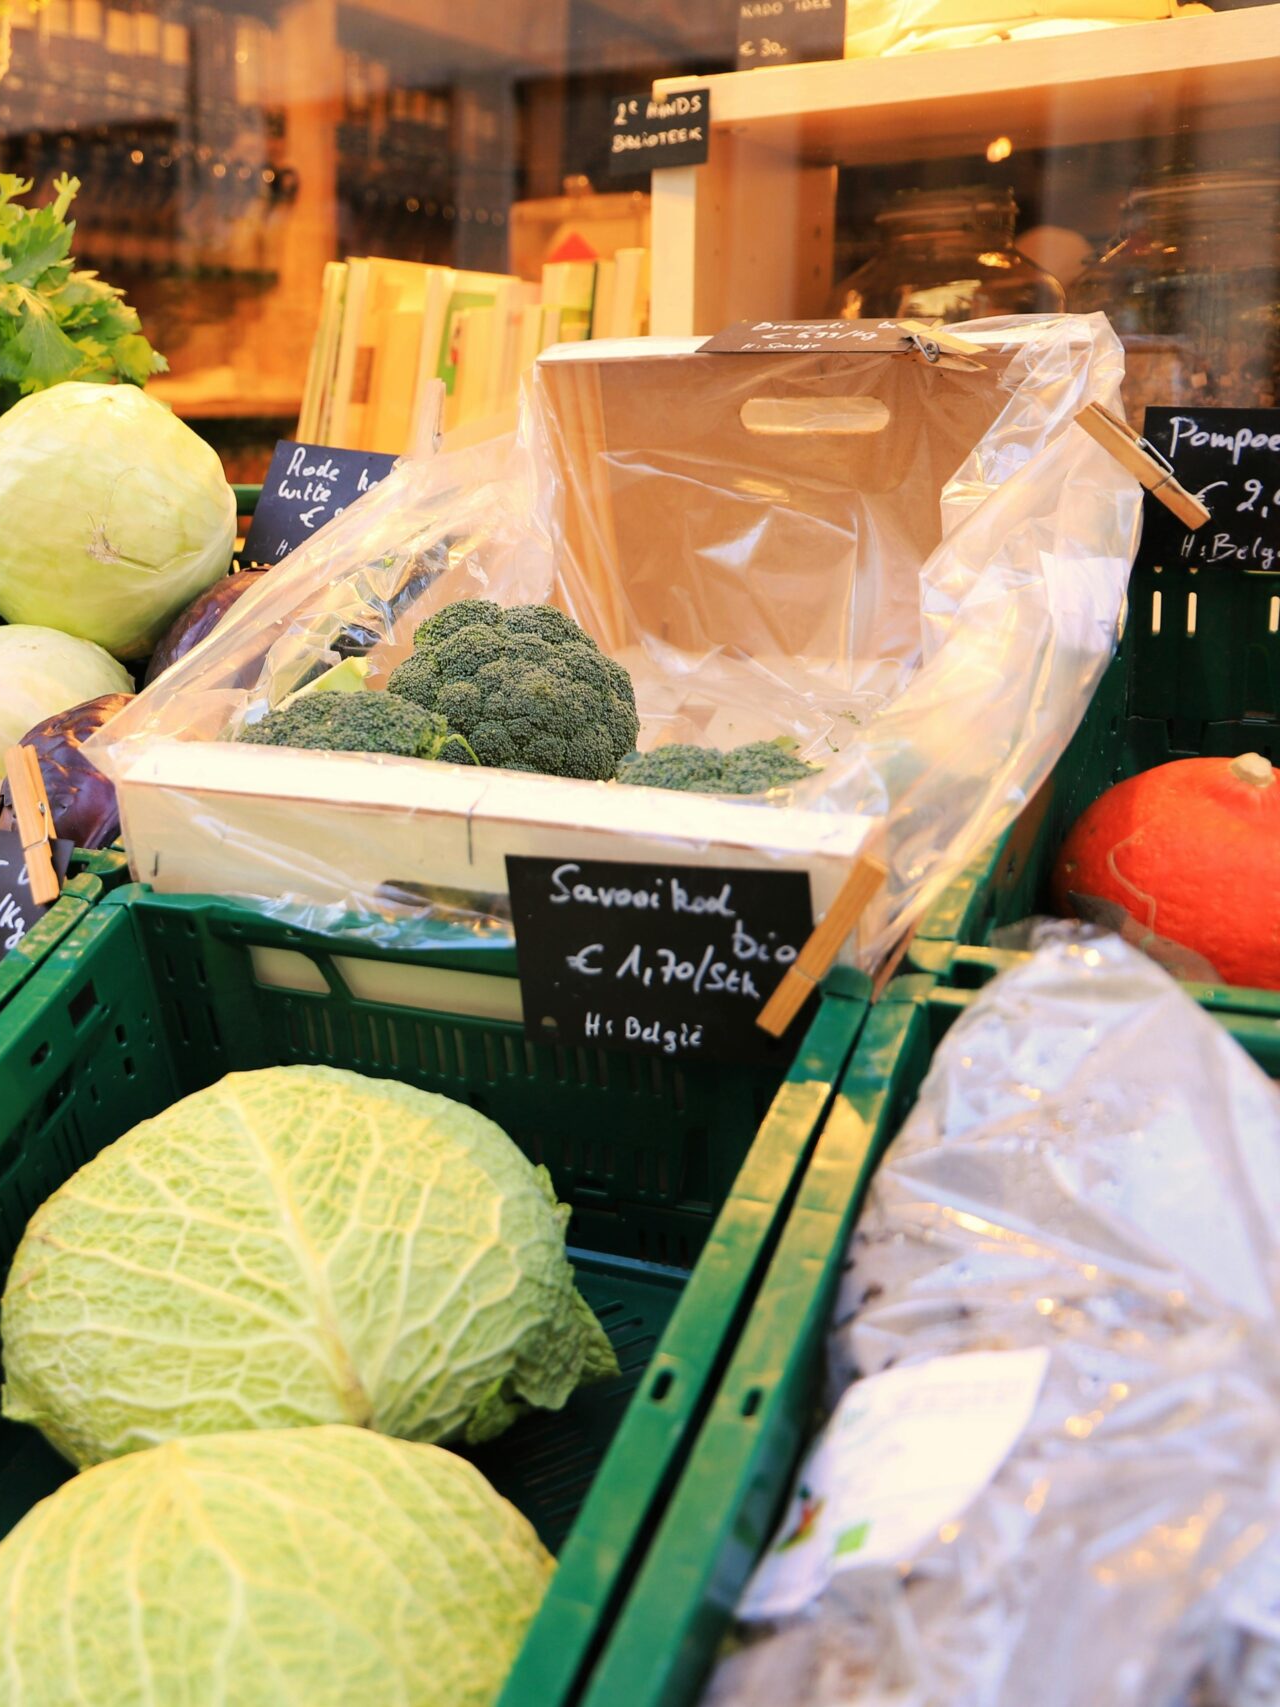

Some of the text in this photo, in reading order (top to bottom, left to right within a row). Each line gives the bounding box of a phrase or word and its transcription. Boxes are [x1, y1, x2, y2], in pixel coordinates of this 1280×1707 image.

[285, 446, 341, 483] Rode
[299, 505, 325, 528] €
[565, 943, 604, 975] €
[731, 918, 799, 963] bio
[624, 1015, 704, 1053] België
